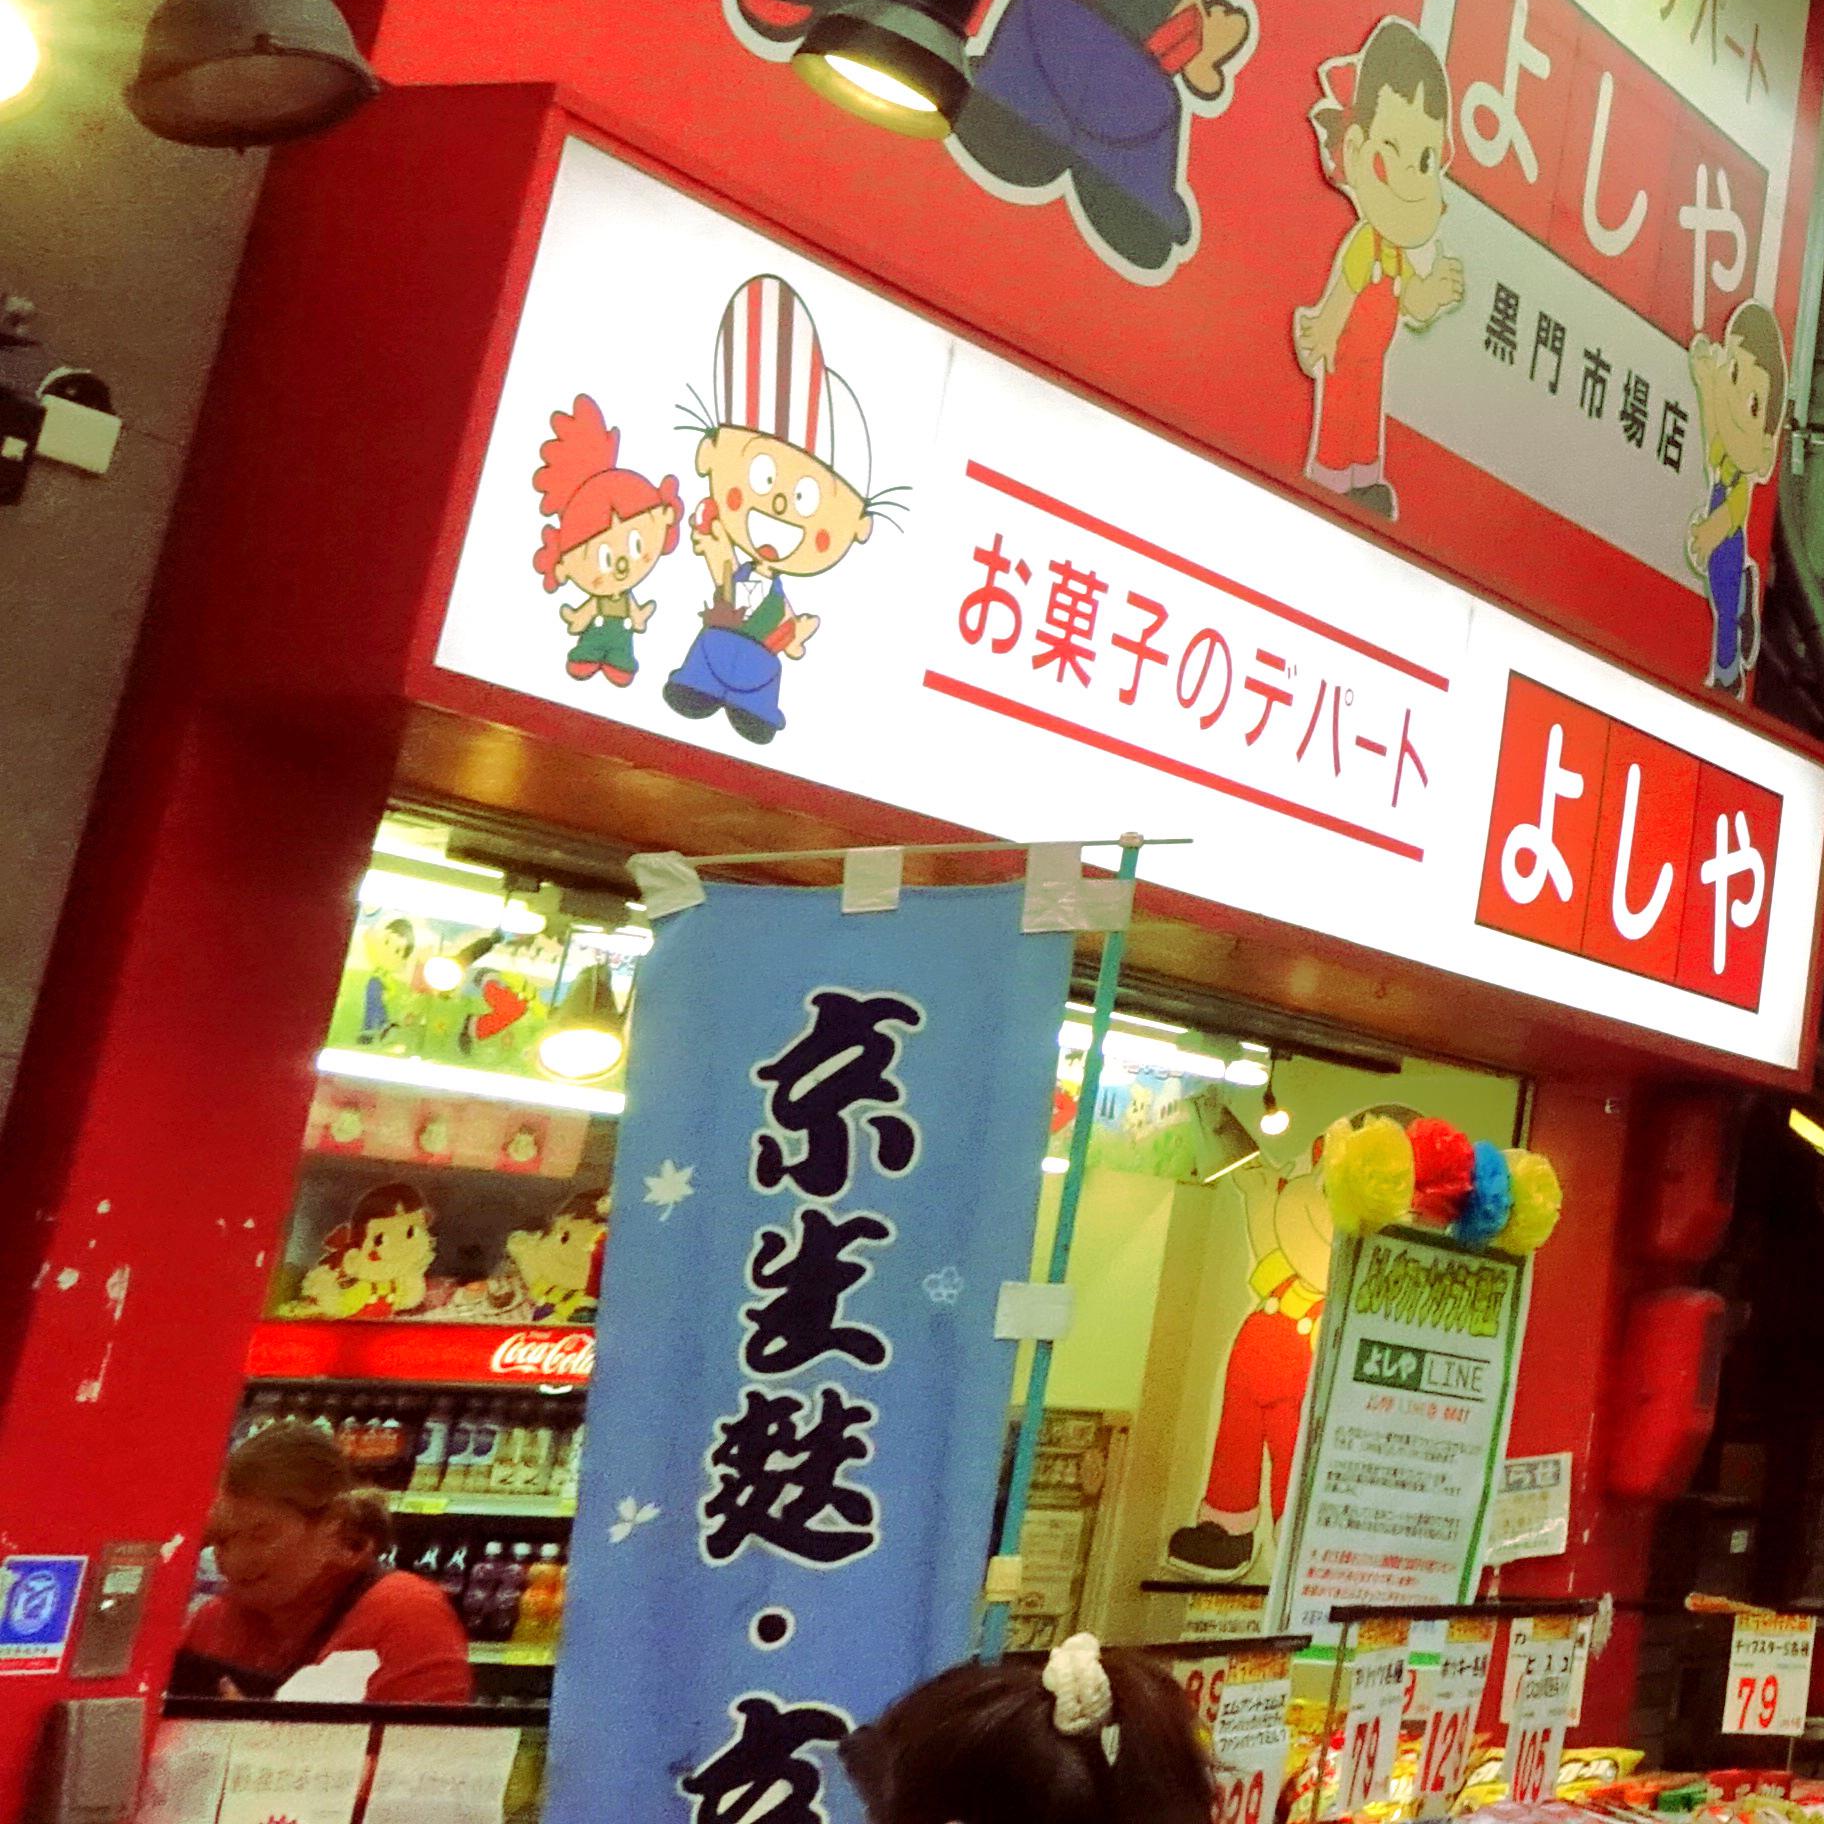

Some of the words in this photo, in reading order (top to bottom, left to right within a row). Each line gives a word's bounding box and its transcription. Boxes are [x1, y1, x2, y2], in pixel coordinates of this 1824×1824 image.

[1484, 281, 1690, 476] 黒門市場店
[957, 531, 1431, 809] お菓子のデパート
[1500, 722, 1768, 976] よしや
[1363, 1344, 1418, 1382] よしや
[1428, 1359, 1485, 1394] LINE
[1737, 1674, 1779, 1732] 79
